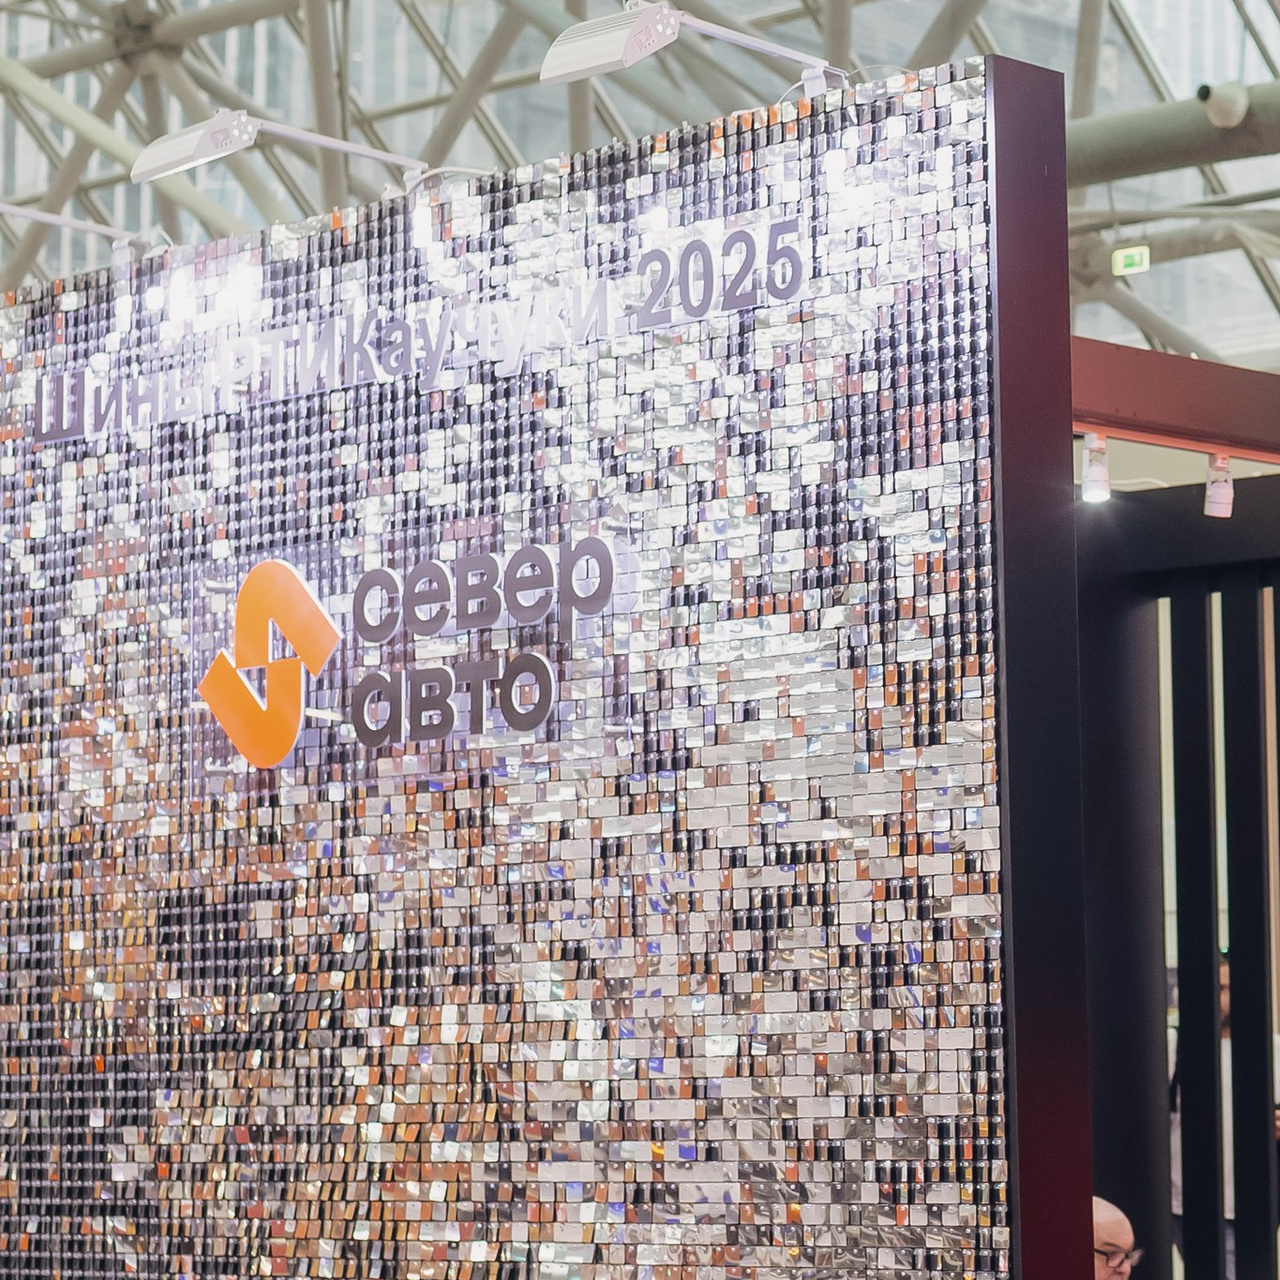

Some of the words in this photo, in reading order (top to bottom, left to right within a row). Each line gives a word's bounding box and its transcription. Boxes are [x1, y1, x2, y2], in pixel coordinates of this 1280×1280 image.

[637, 221, 802, 329] 2025
[353, 536, 614, 642] север
[353, 653, 553, 747] авто
